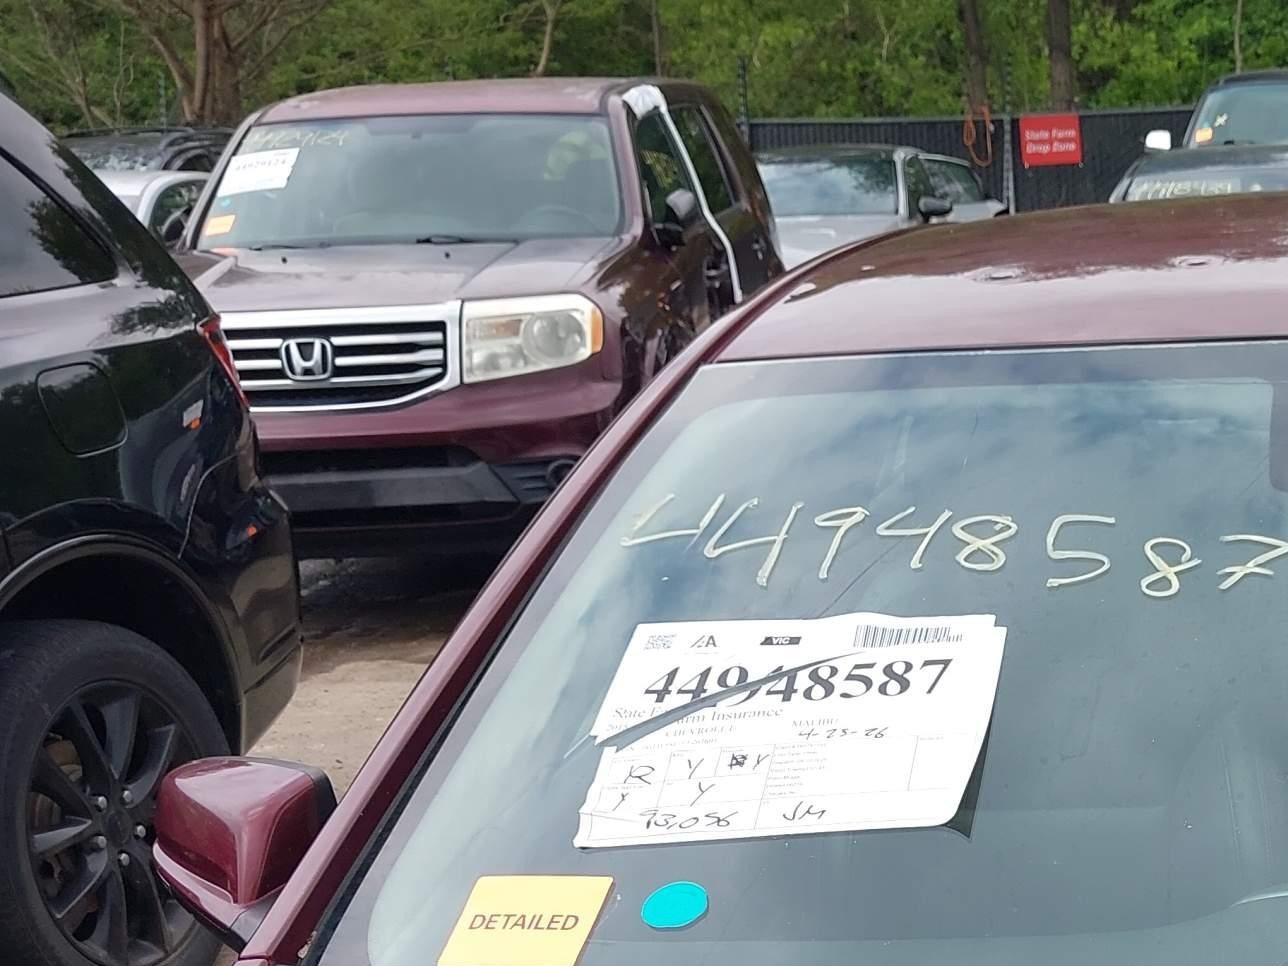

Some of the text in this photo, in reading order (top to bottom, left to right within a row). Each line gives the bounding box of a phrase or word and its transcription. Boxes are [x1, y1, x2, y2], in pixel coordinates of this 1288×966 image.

[1024, 128, 1076, 140] State Farm
[1026, 141, 1076, 154] Drop Zone
[644, 658, 953, 708] 44948587
[613, 706, 647, 720] State
[711, 707, 784, 722] Insurance
[468, 914, 579, 931] DETAILED
